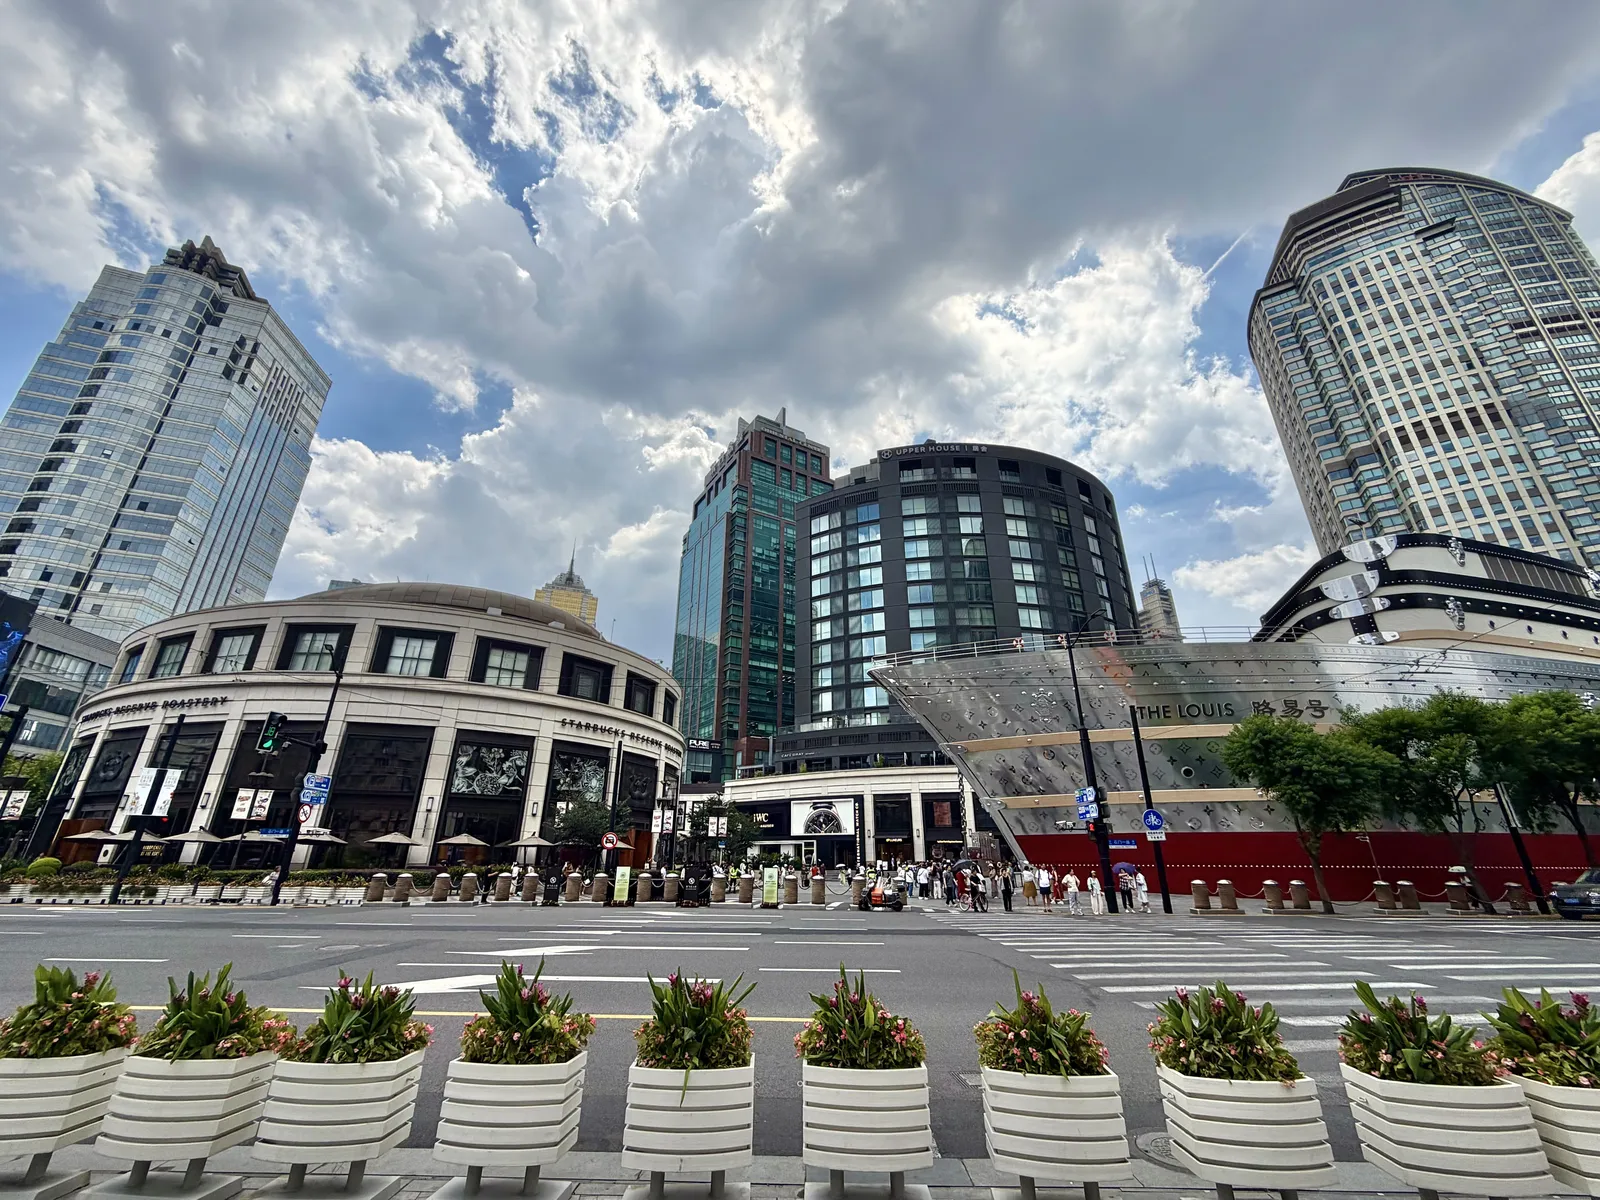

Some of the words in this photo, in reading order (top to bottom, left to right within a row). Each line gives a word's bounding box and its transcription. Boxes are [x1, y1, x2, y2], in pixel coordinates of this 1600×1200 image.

[896, 446, 926, 456] UPPER
[161, 696, 227, 709] ROASTERY
[1251, 699, 1330, 719] 路易号
[1137, 705, 1171, 720] THE
[1177, 702, 1235, 718] LOUIS
[561, 718, 626, 738] STARBUCKS
[629, 732, 663, 749] RESERVE
[753, 812, 769, 822] IWC
